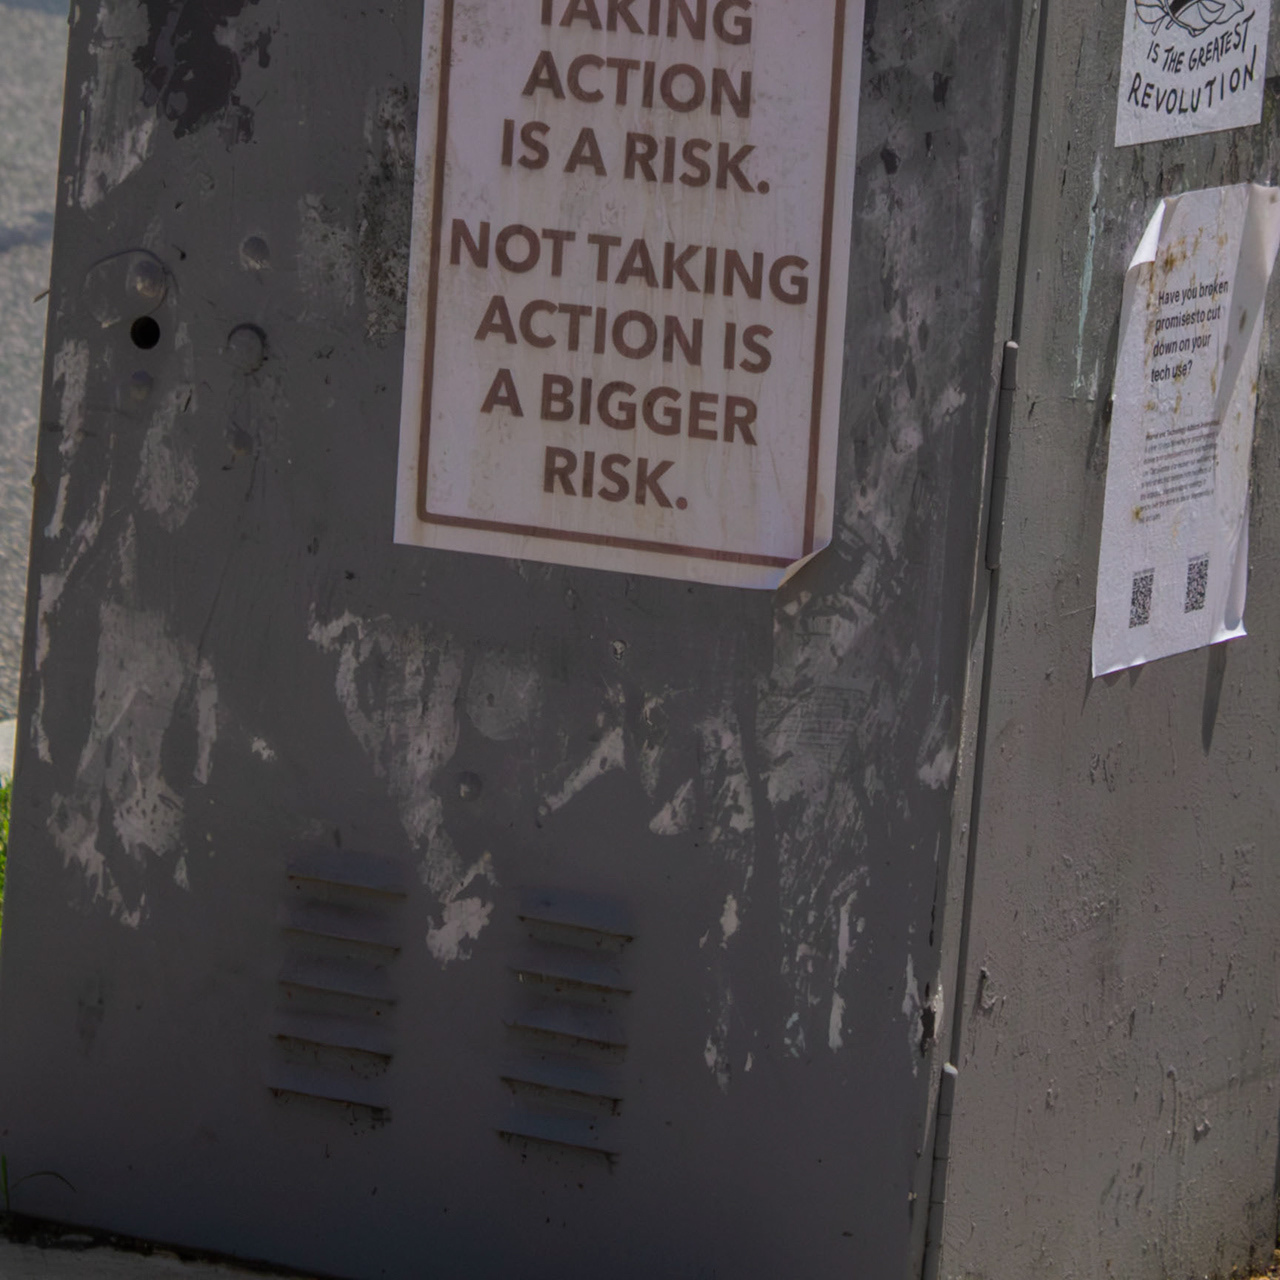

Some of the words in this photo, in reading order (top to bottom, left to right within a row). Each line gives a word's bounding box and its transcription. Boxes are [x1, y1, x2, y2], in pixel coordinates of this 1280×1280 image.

[1147, 40, 1160, 63] IS
[1162, 46, 1185, 74] THE
[1188, 10, 1256, 71] GREATEST
[522, 50, 752, 118] ACTION
[1127, 44, 1257, 115] REVOLUTION
[501, 118, 550, 170] IS
[563, 127, 607, 176] A
[624, 132, 770, 195] RISK.
[449, 218, 576, 278] NOT
[587, 233, 810, 305] TAKING
[1158, 290, 1180, 306] Have
[1181, 287, 1197, 305] you
[1199, 281, 1229, 298] broken
[474, 295, 703, 367] ACTION
[723, 322, 774, 374] IS
[1153, 341, 1178, 358] down
[1179, 339, 1190, 352] on
[1192, 334, 1211, 352] your
[1206, 306, 1221, 320] cut
[1151, 365, 1170, 383] tech
[1172, 360, 1193, 378] use?
[480, 368, 524, 418] A
[541, 373, 758, 447] BIGGER
[544, 446, 688, 511] RISK.
